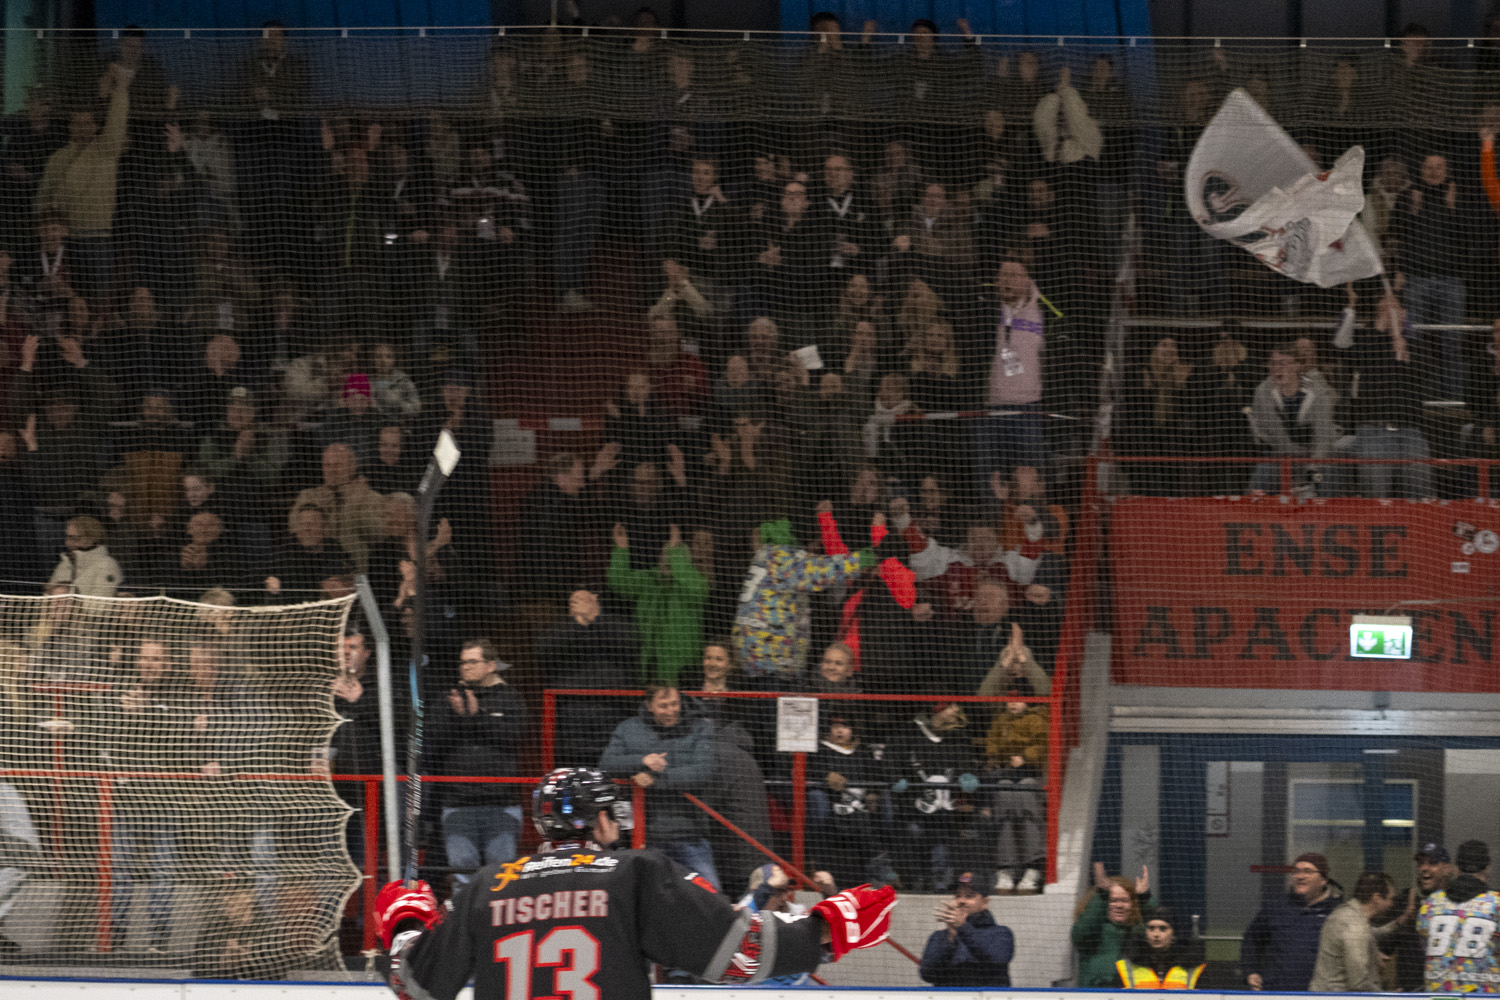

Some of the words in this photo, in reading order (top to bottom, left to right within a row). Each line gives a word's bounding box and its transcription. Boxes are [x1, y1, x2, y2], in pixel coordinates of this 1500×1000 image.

[1222, 523, 1408, 578] ENSE
[1133, 606, 1498, 664] APACEN
[489, 889, 609, 927] TISCHER
[1426, 915, 1498, 959] 88
